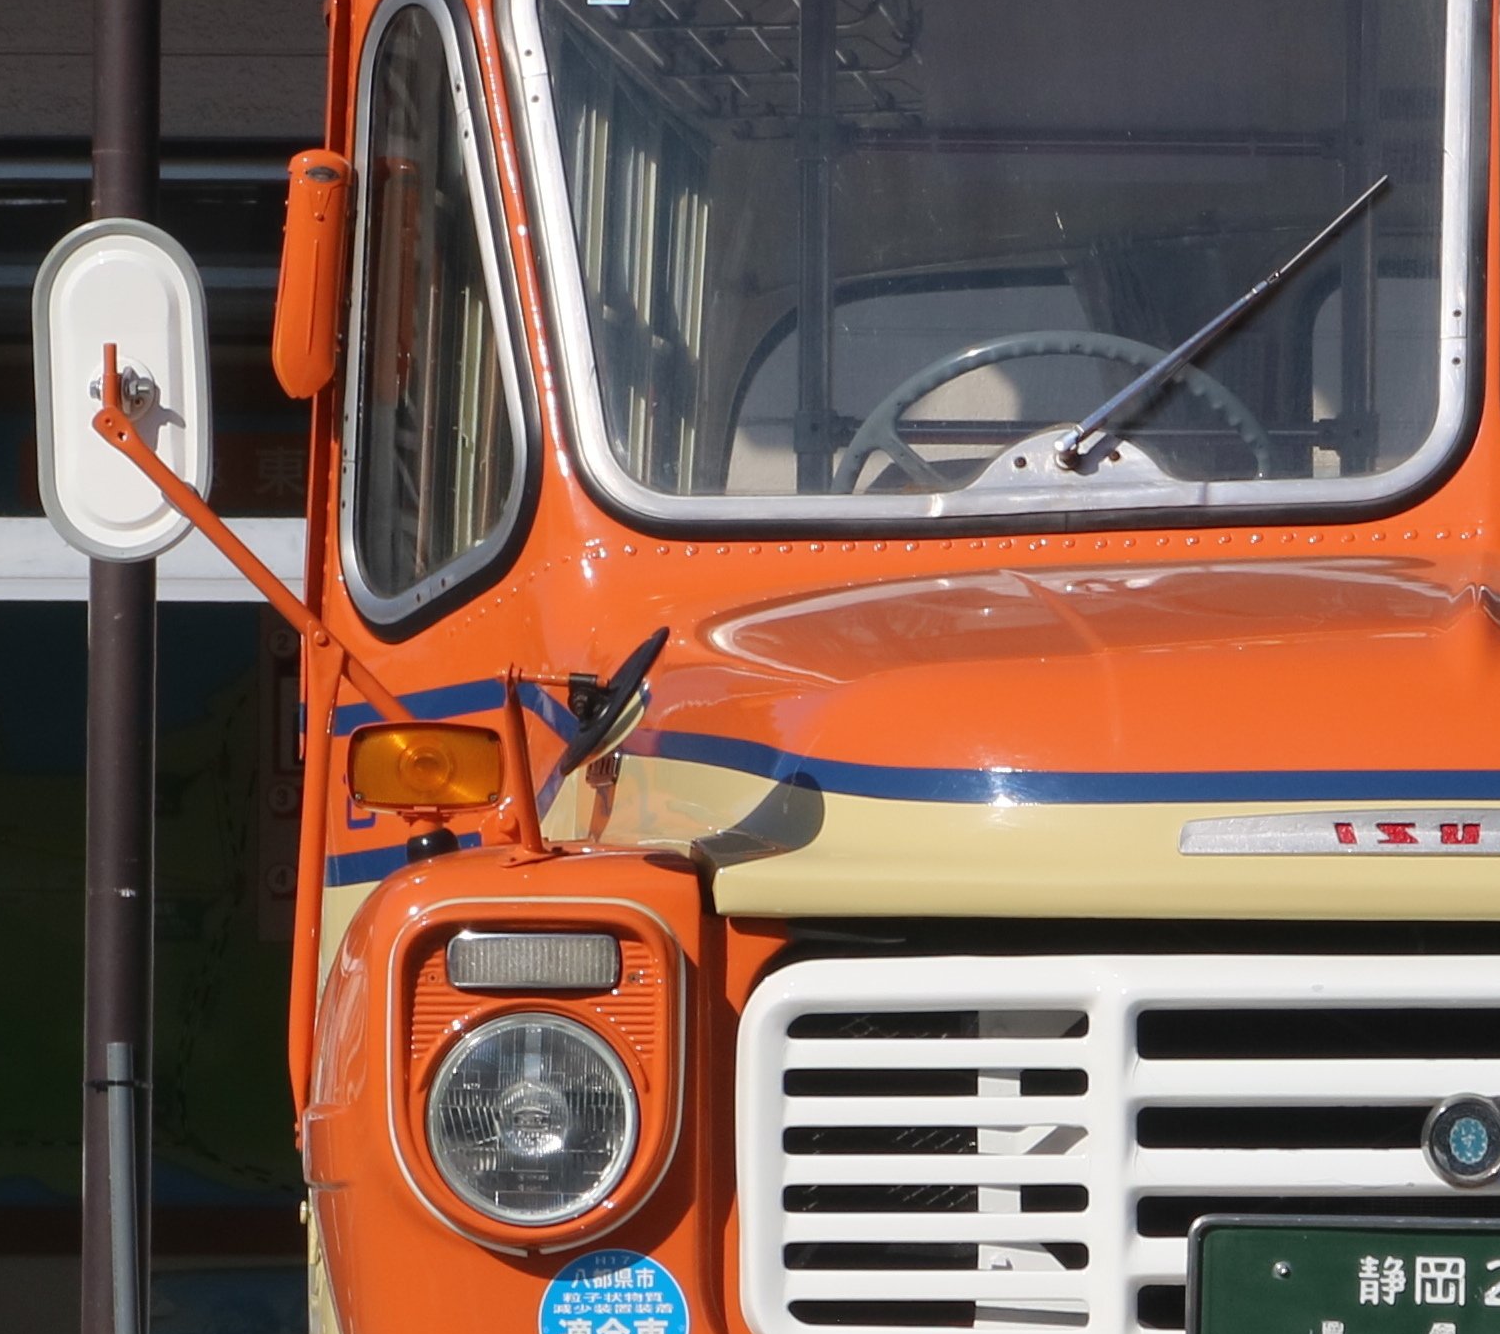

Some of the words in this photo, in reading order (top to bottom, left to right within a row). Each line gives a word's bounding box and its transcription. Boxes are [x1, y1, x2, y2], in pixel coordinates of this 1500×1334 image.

[571, 1267, 655, 1289] 八都県市
[1358, 1256, 1466, 1306] 静岡
[562, 1292, 663, 1303] 粒子状物質
[553, 1303, 673, 1315] 減少装置装着
